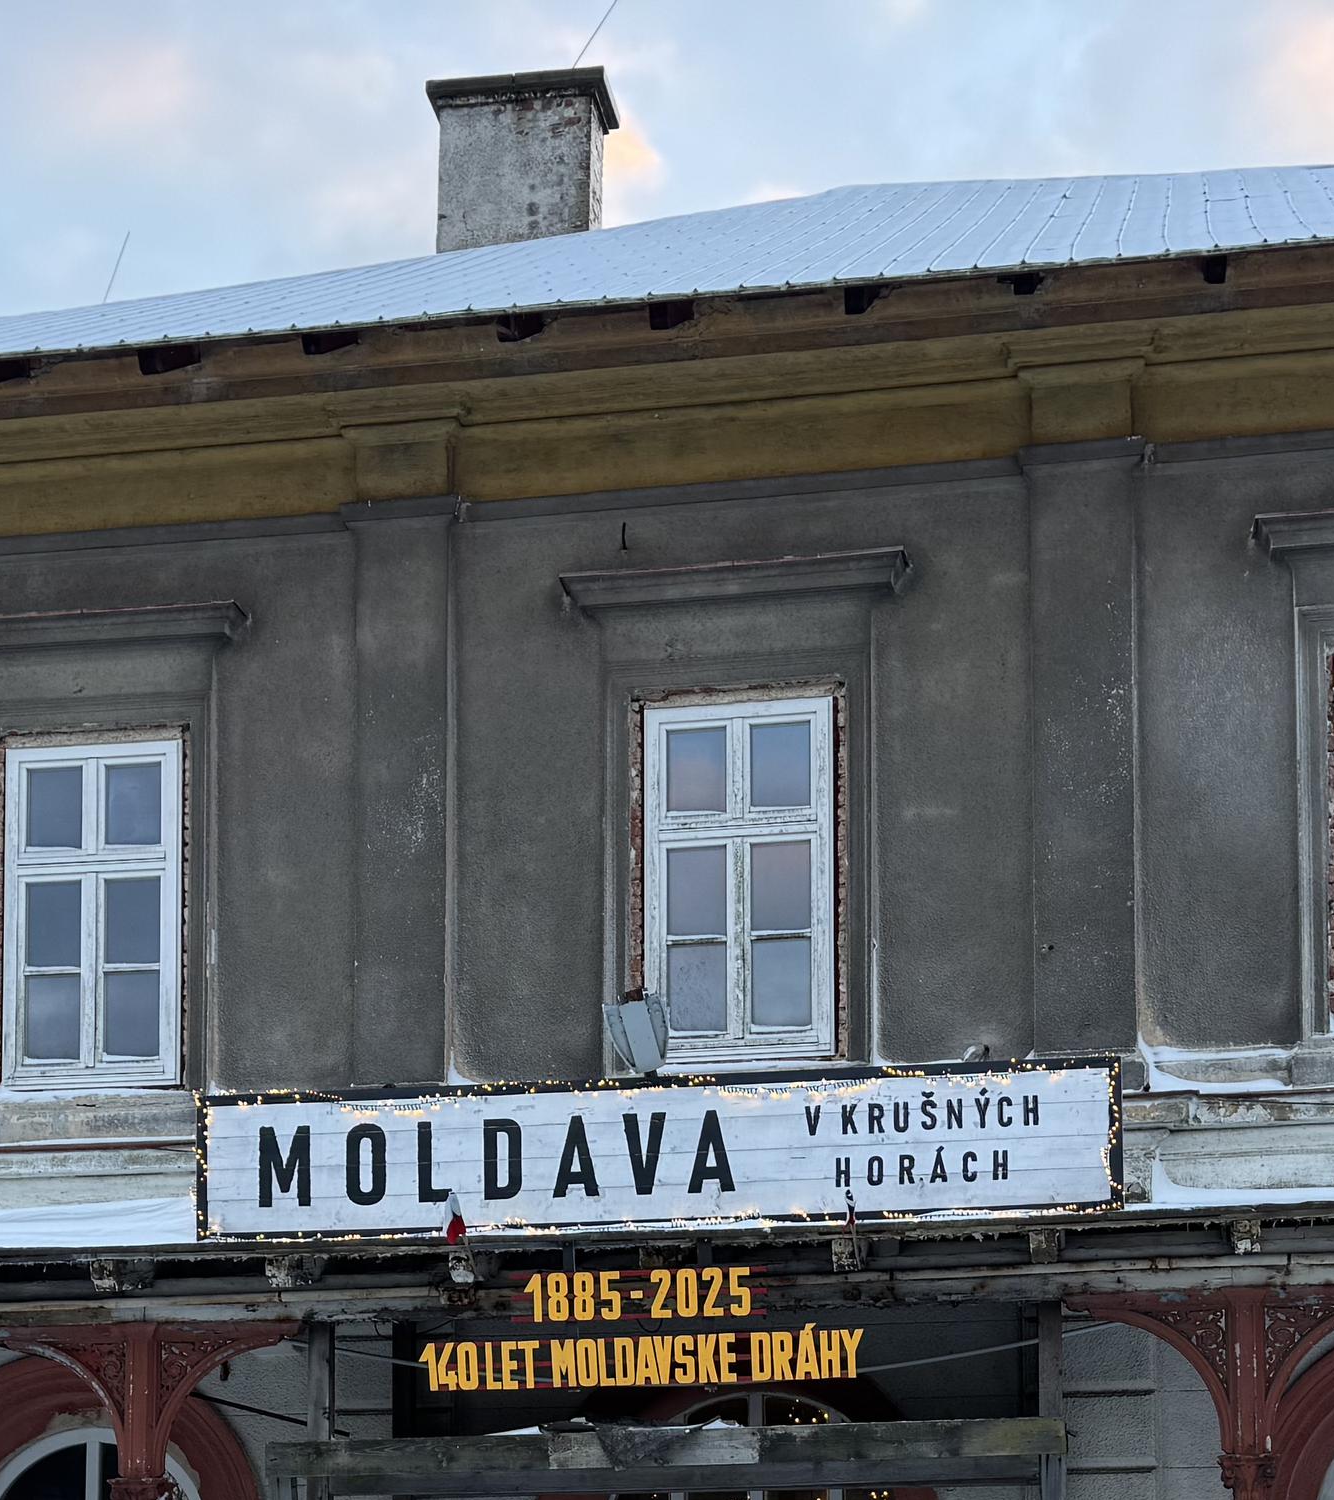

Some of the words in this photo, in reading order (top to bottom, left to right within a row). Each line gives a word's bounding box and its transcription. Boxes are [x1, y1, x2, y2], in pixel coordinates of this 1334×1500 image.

[804, 1104, 821, 1136] V
[841, 1087, 1040, 1135] KRUŠNÝCH
[258, 1109, 736, 1207] MOLDAVA
[835, 1145, 1009, 1188] HORÁCH
[523, 1267, 751, 1322] 1885-2025
[418, 1341, 479, 1391] 140
[484, 1340, 540, 1390] LET
[549, 1333, 738, 1388] MOLDAVSKE
[750, 1322, 864, 1383] DRÁHY
